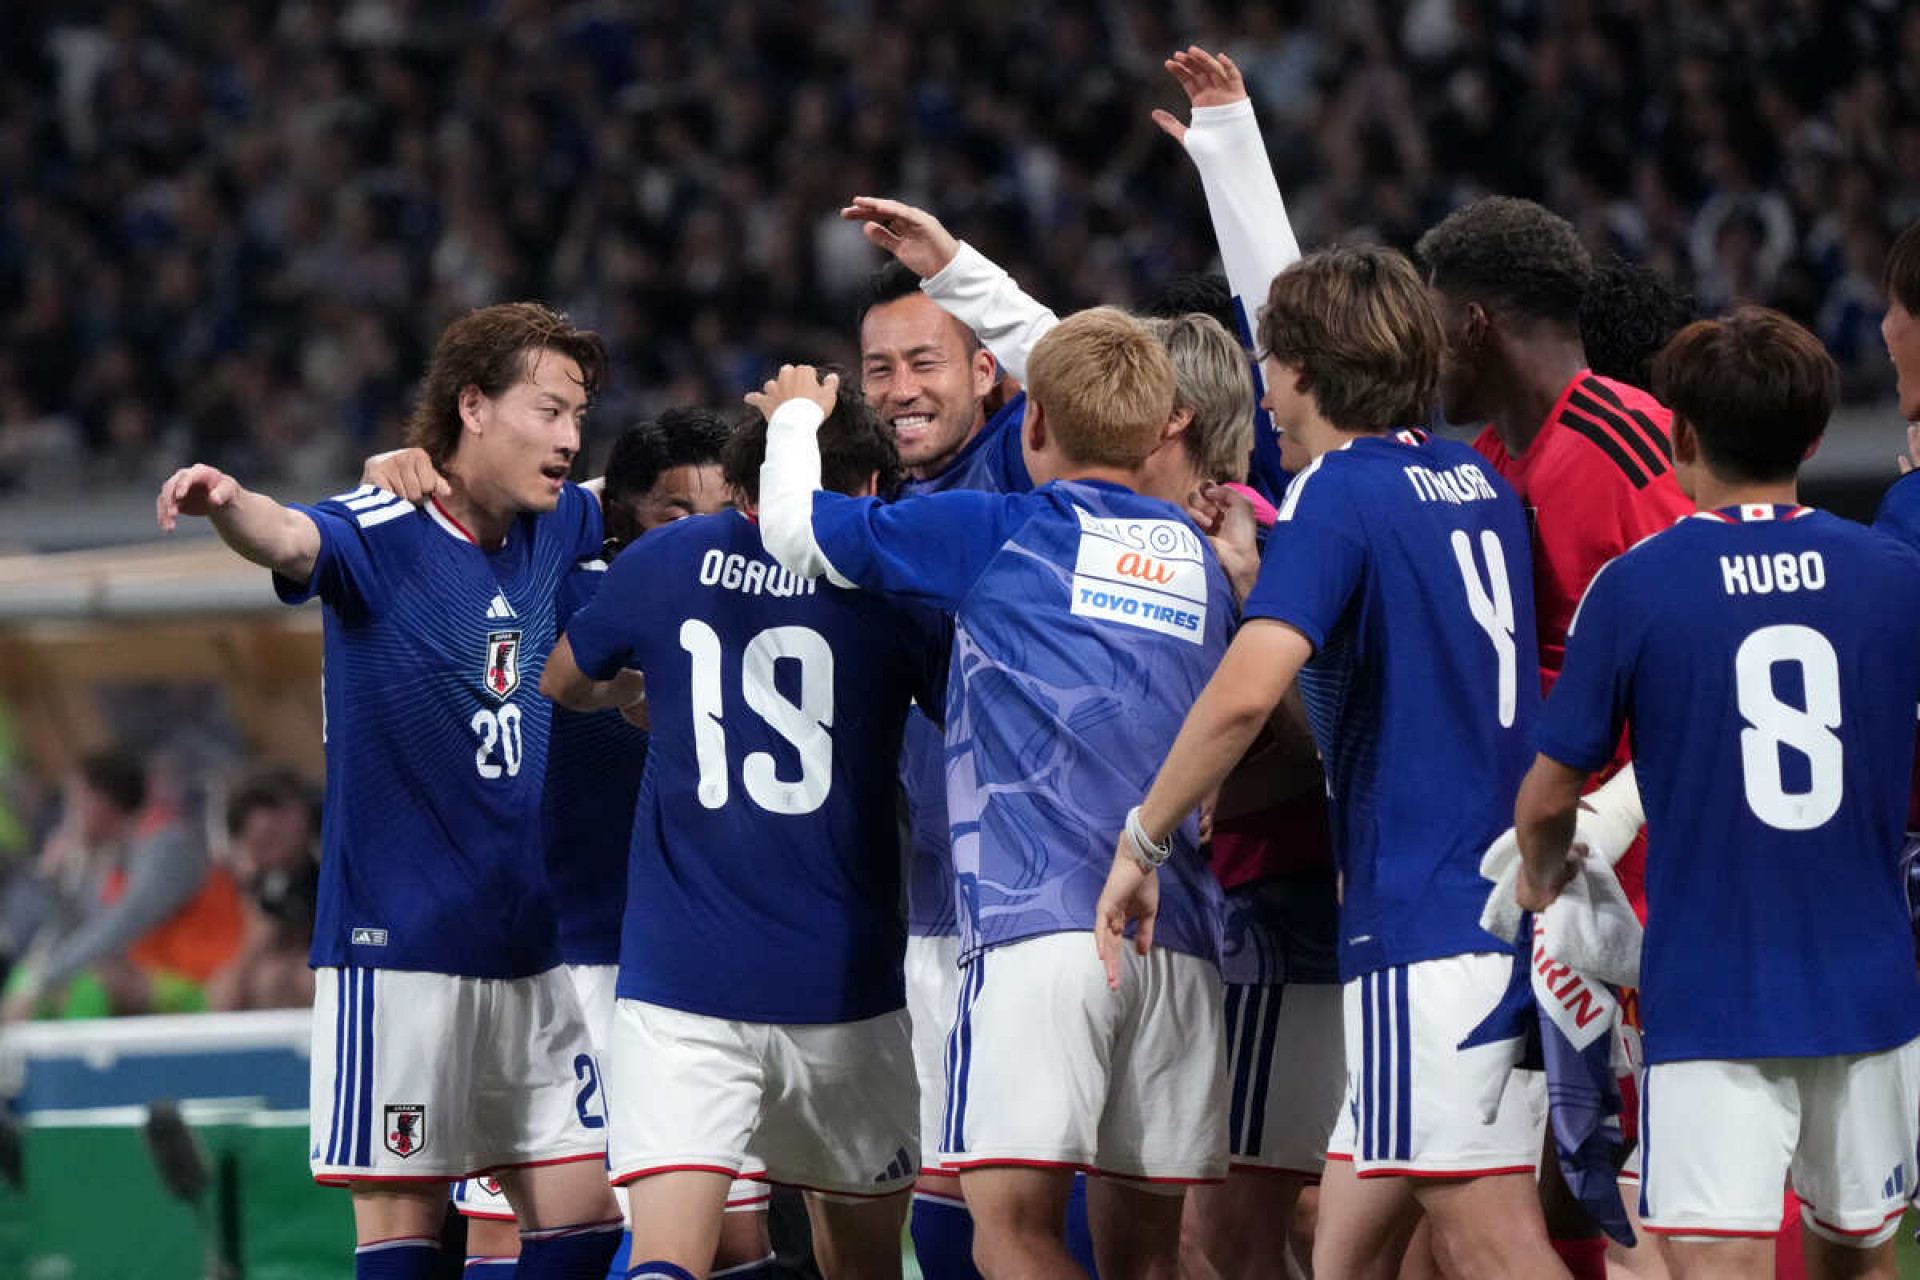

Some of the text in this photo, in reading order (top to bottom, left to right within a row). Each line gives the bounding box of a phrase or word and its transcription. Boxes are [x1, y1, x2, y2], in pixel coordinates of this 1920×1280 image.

[1116, 552, 1176, 584] au
[1719, 550, 1826, 595] KUBO
[1080, 588, 1200, 631] TOYO TIRES
[471, 703, 522, 779] 20
[679, 618, 834, 814] 19
[1735, 623, 1843, 830] 8
[1533, 916, 1605, 1030] RIN
[574, 1053, 609, 1129] 2
